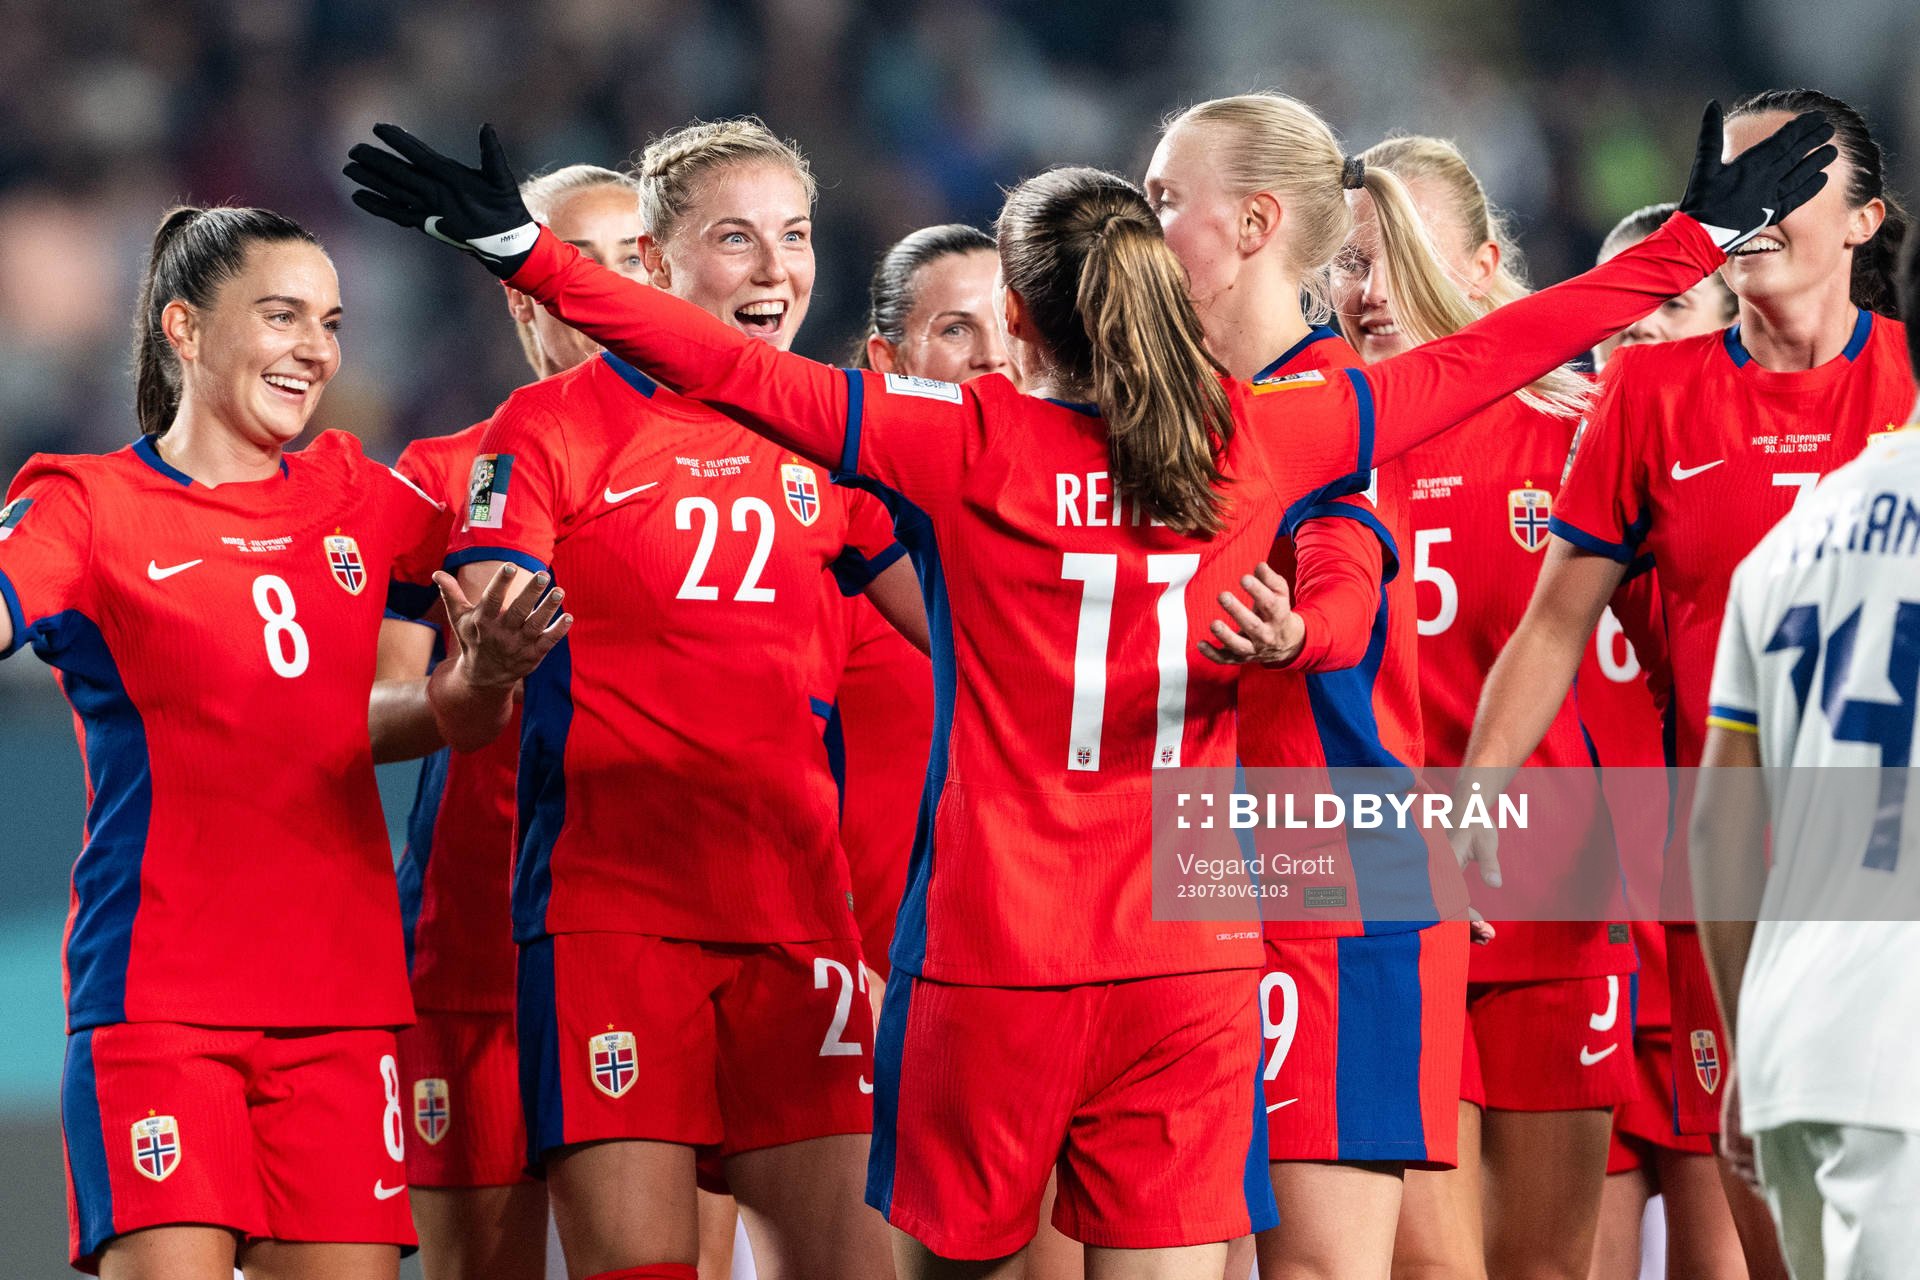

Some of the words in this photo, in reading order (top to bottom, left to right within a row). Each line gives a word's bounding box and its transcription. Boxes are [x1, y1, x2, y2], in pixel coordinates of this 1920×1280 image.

[675, 456, 700, 468] NORGE
[706, 455, 751, 468] FILIPPINENE
[703, 468, 719, 477] JULI
[720, 466, 741, 476] 2023
[1752, 435, 1778, 445] NORGE
[1785, 433, 1832, 444] FILIPPINENE
[1779, 444, 1795, 454] JULI
[1797, 443, 1818, 453] 2023
[675, 496, 776, 603] 22
[1413, 527, 1459, 637] 5
[252, 574, 310, 678] 8
[1061, 552, 1200, 771] 11
[1260, 971, 1299, 1081] 9
[379, 1054, 405, 1162] 8
